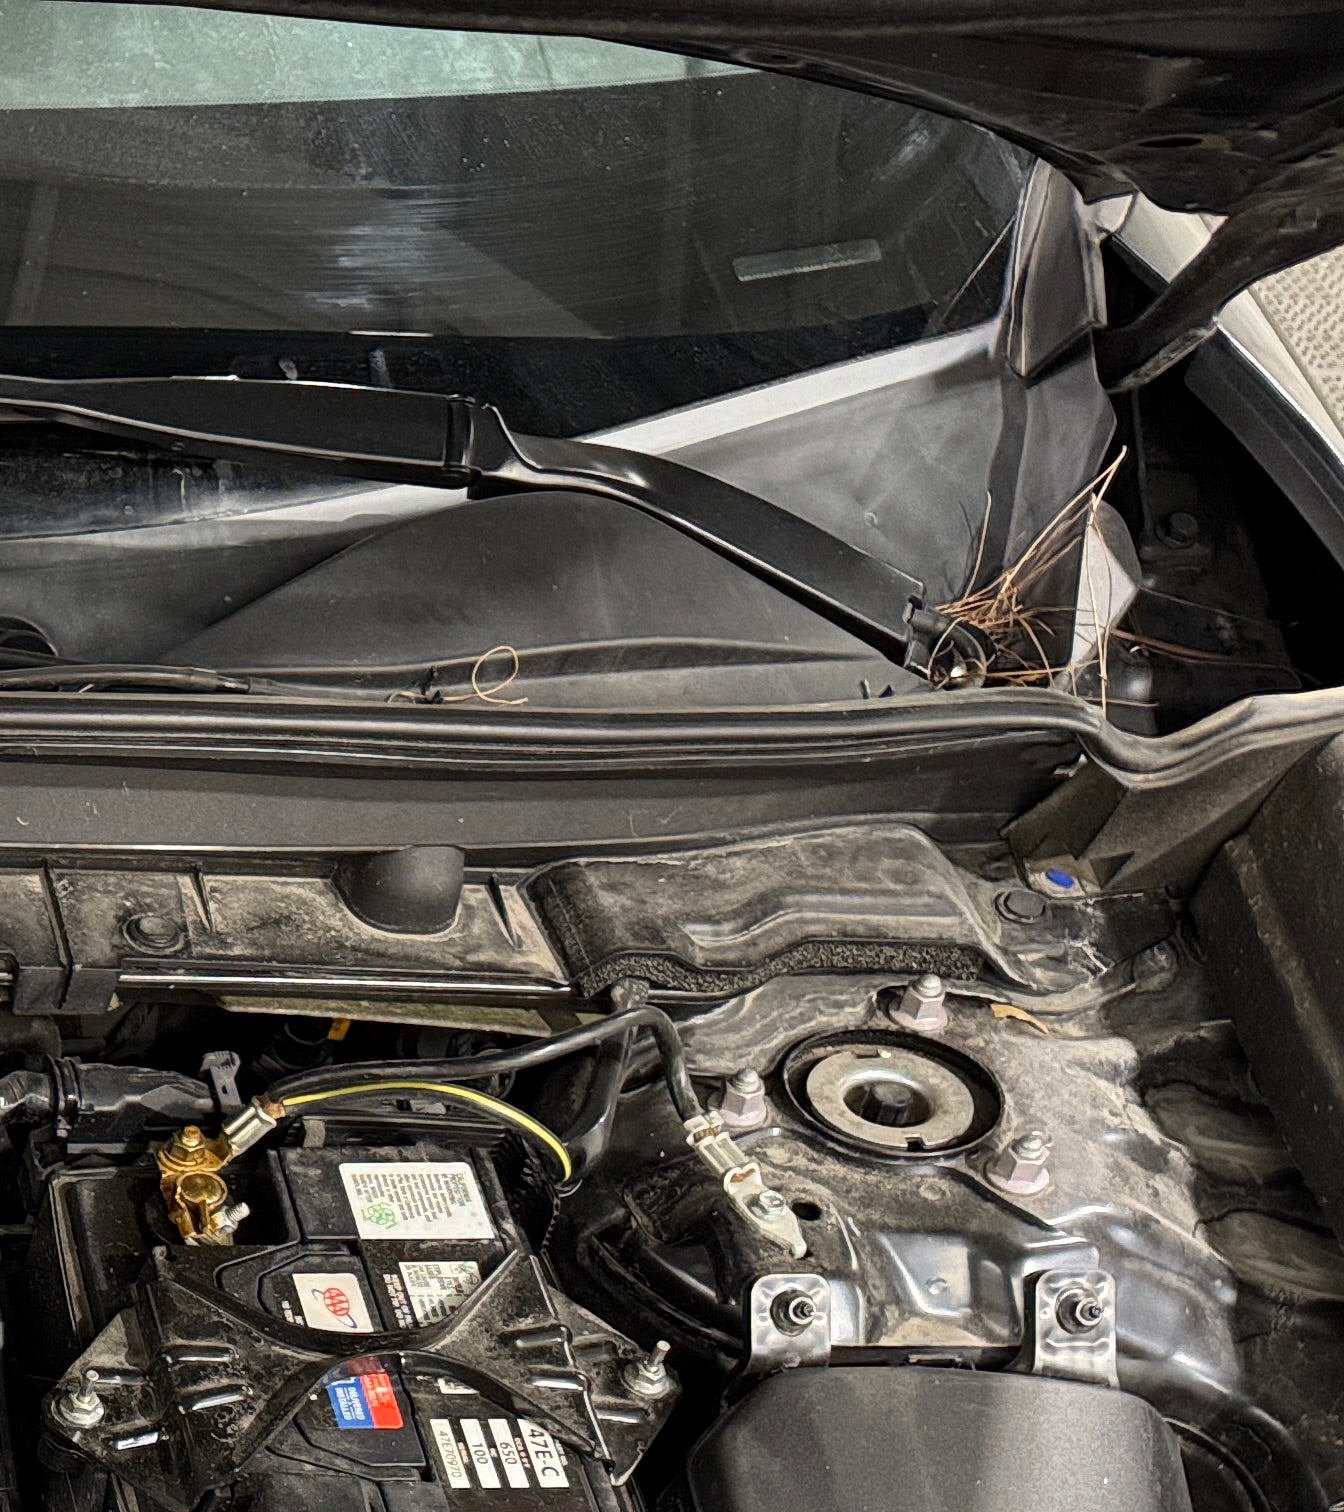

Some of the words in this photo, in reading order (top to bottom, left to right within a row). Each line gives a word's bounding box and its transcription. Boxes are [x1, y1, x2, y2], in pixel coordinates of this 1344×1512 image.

[325, 1288, 349, 1316] AAA
[438, 1430, 463, 1478] 47E70970
[471, 1442, 489, 1465] 100
[499, 1442, 518, 1465] 650
[528, 1428, 560, 1477] 47E-C
